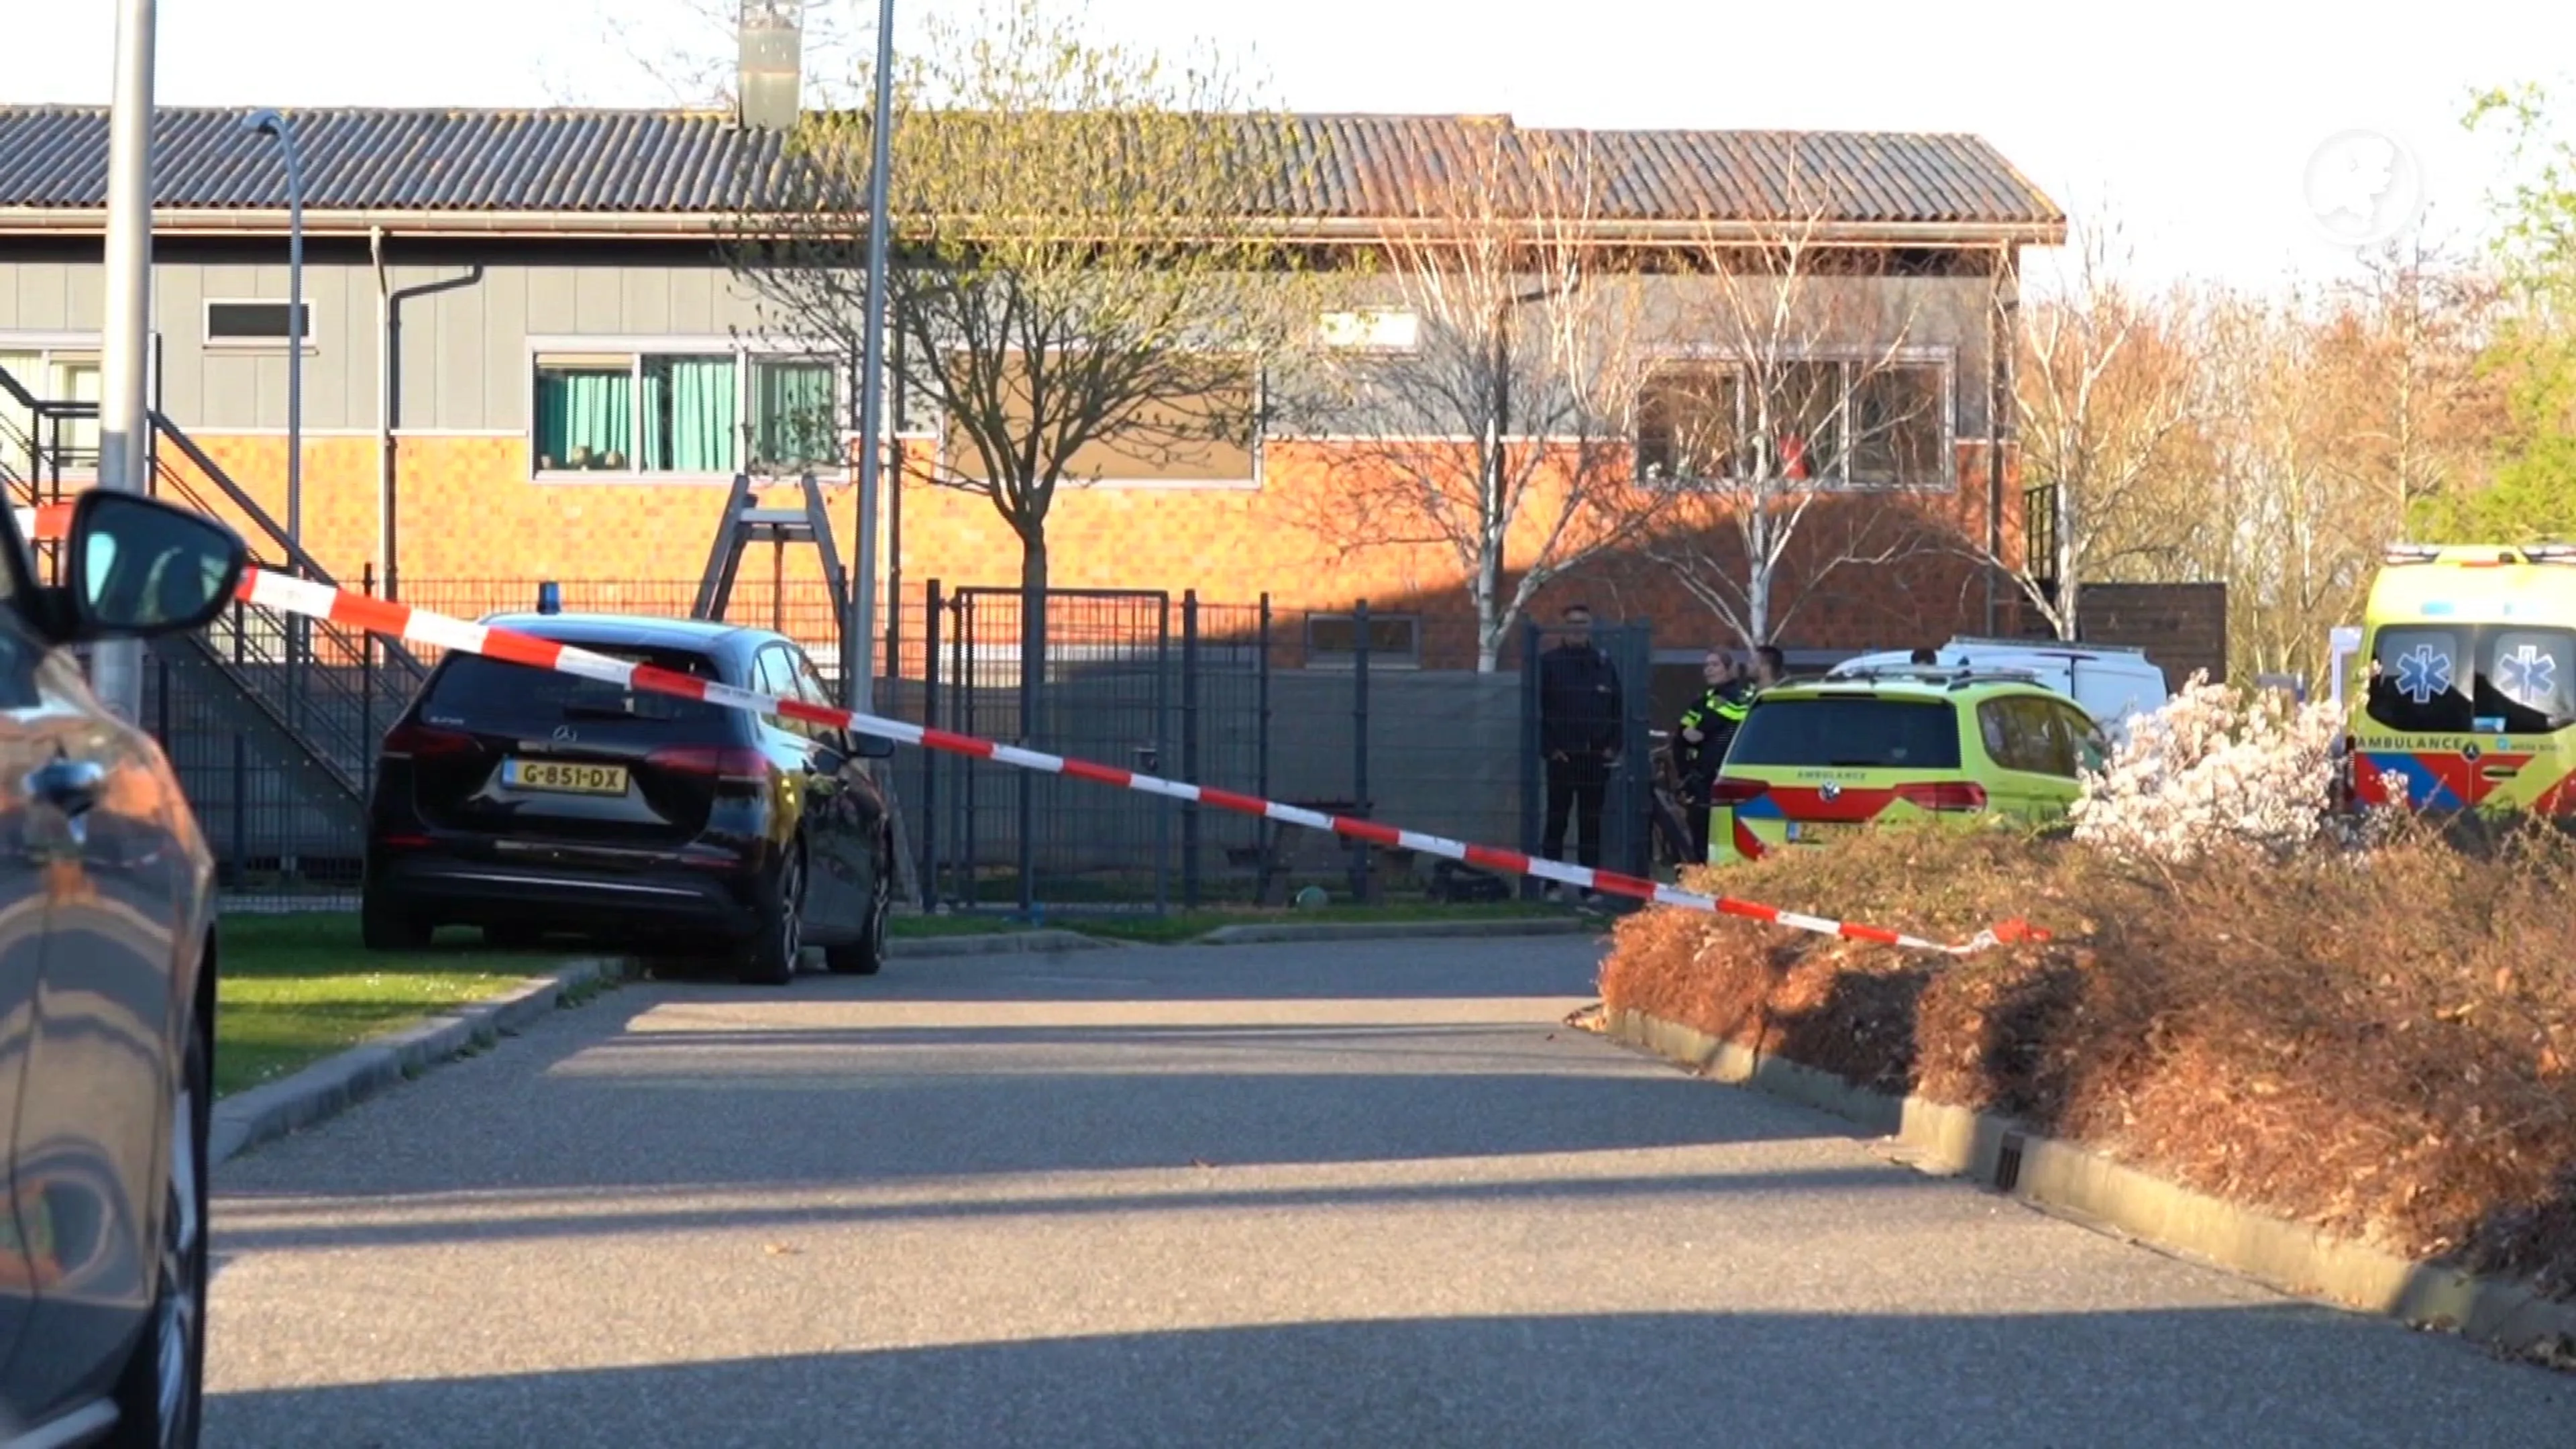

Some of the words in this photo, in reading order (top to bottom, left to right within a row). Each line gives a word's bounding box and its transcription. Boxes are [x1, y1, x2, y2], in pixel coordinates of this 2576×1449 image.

[2357, 737, 2462, 749] AMBULANCE
[523, 764, 619, 788] G-851-DX
[1796, 770, 1867, 780] AMBULANCE
